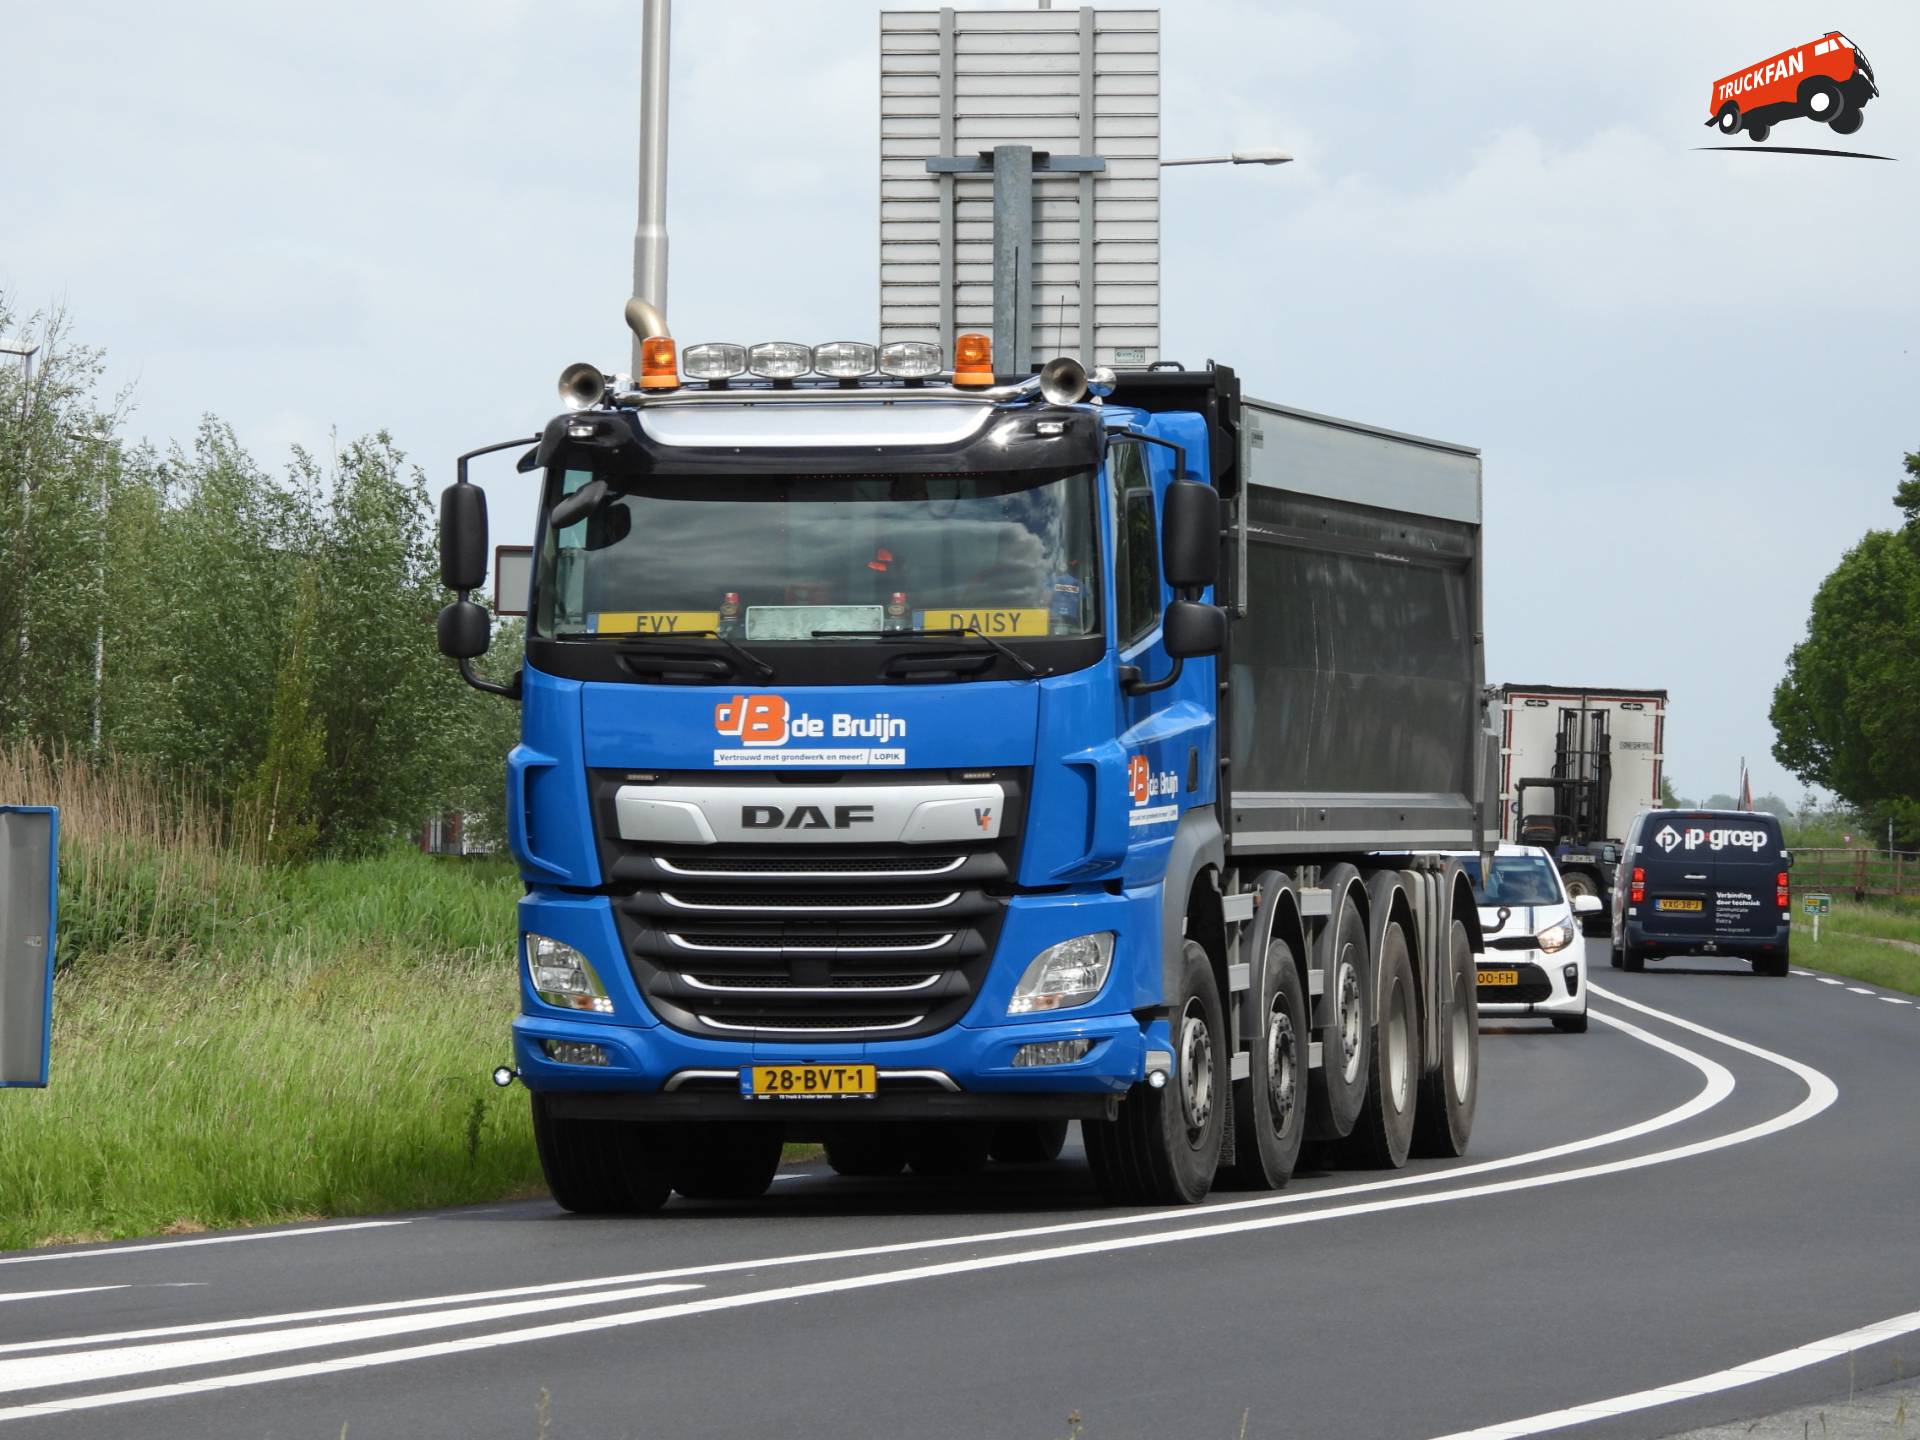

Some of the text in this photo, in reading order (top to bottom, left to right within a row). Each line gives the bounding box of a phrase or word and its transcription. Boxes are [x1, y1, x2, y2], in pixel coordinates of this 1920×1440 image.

[950, 613, 1021, 633] DAISY
[791, 713, 906, 743] de Bruijn
[719, 753, 762, 761] Vertrouwd
[781, 753, 824, 762] grondwerk
[838, 753, 863, 761] meer!
[1149, 770, 1179, 799] de Bruijn
[741, 805, 874, 829] DAF
[1716, 891, 1752, 900] Verbinding
[765, 1069, 863, 1090] 28-BVT-1
